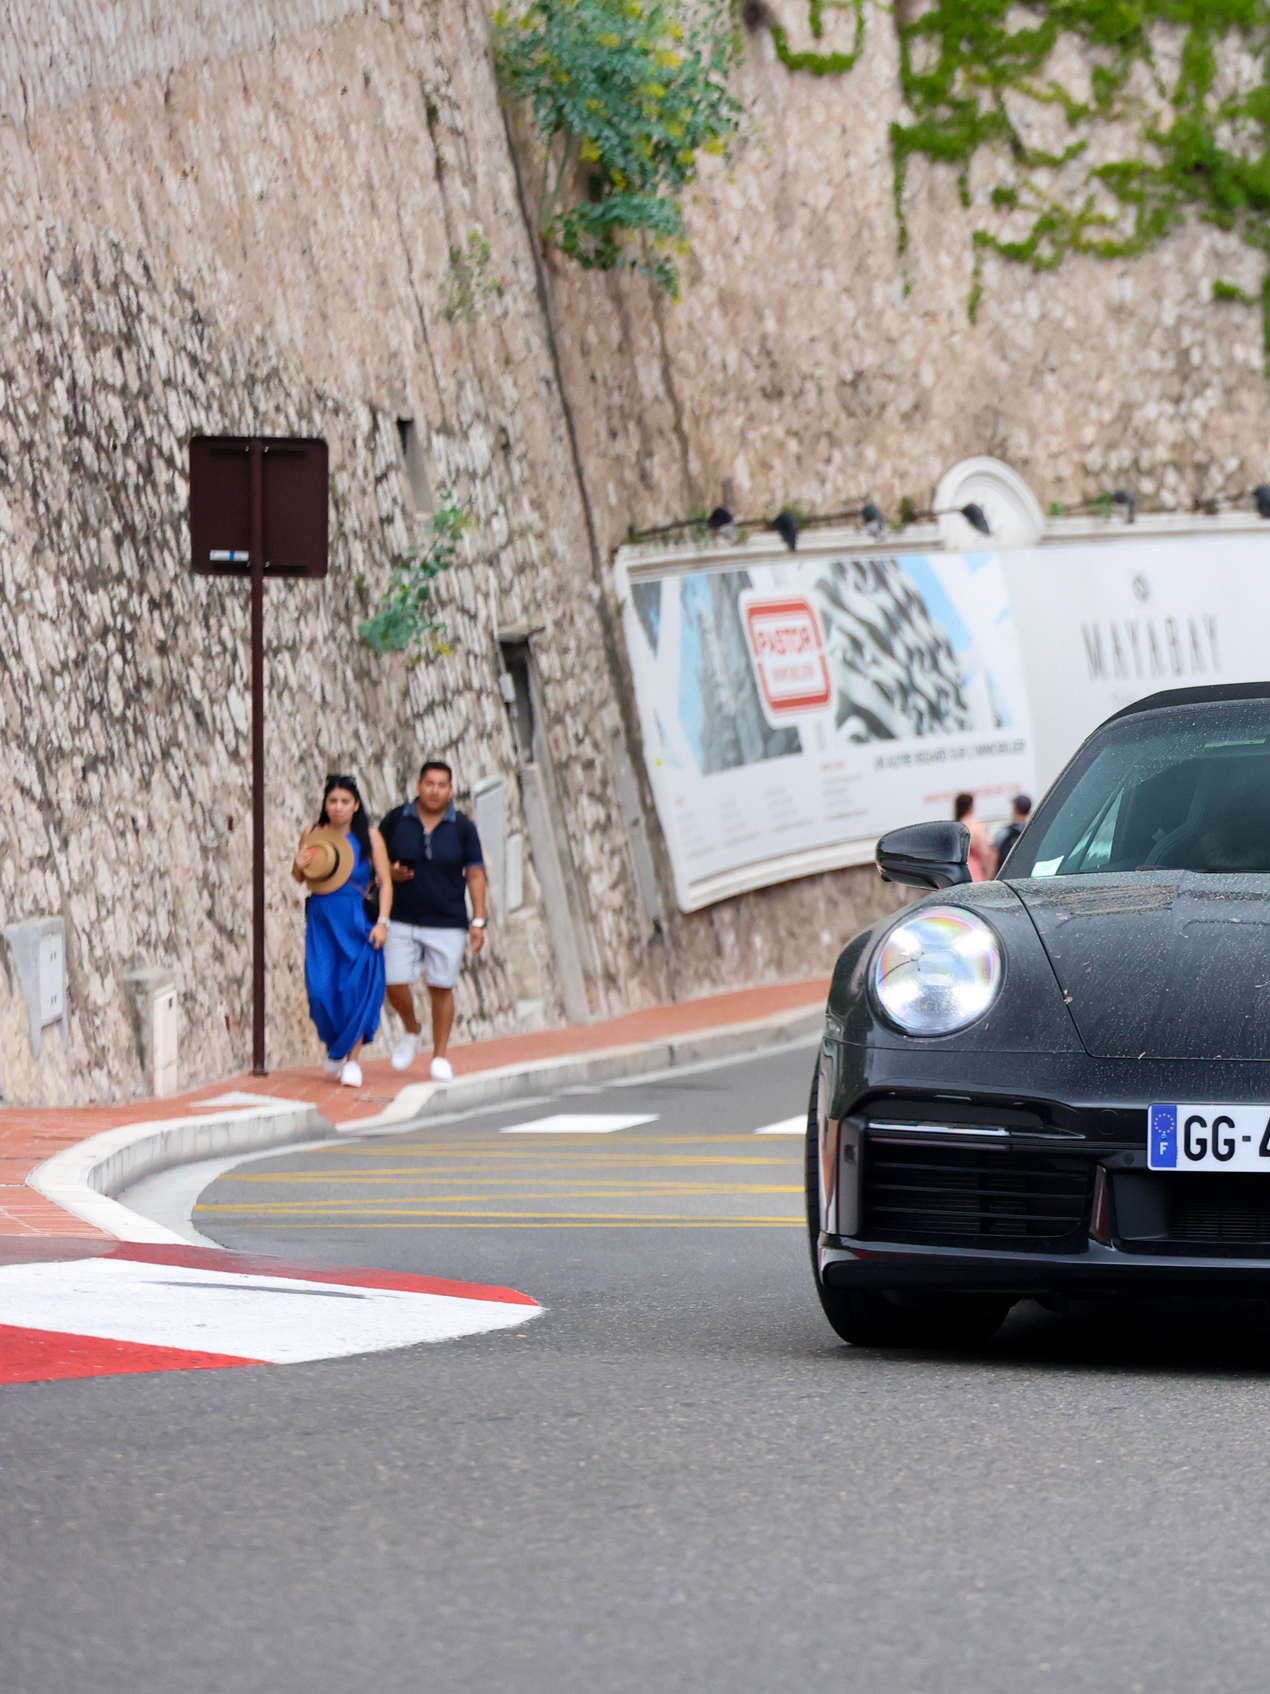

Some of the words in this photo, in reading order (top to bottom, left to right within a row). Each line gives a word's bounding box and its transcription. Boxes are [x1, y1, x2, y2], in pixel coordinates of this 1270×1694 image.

[757, 627, 816, 656] PASTOR
[1080, 613, 1221, 684] MAYABAY
[915, 748, 946, 766] REGARD
[1159, 1142, 1168, 1156] F
